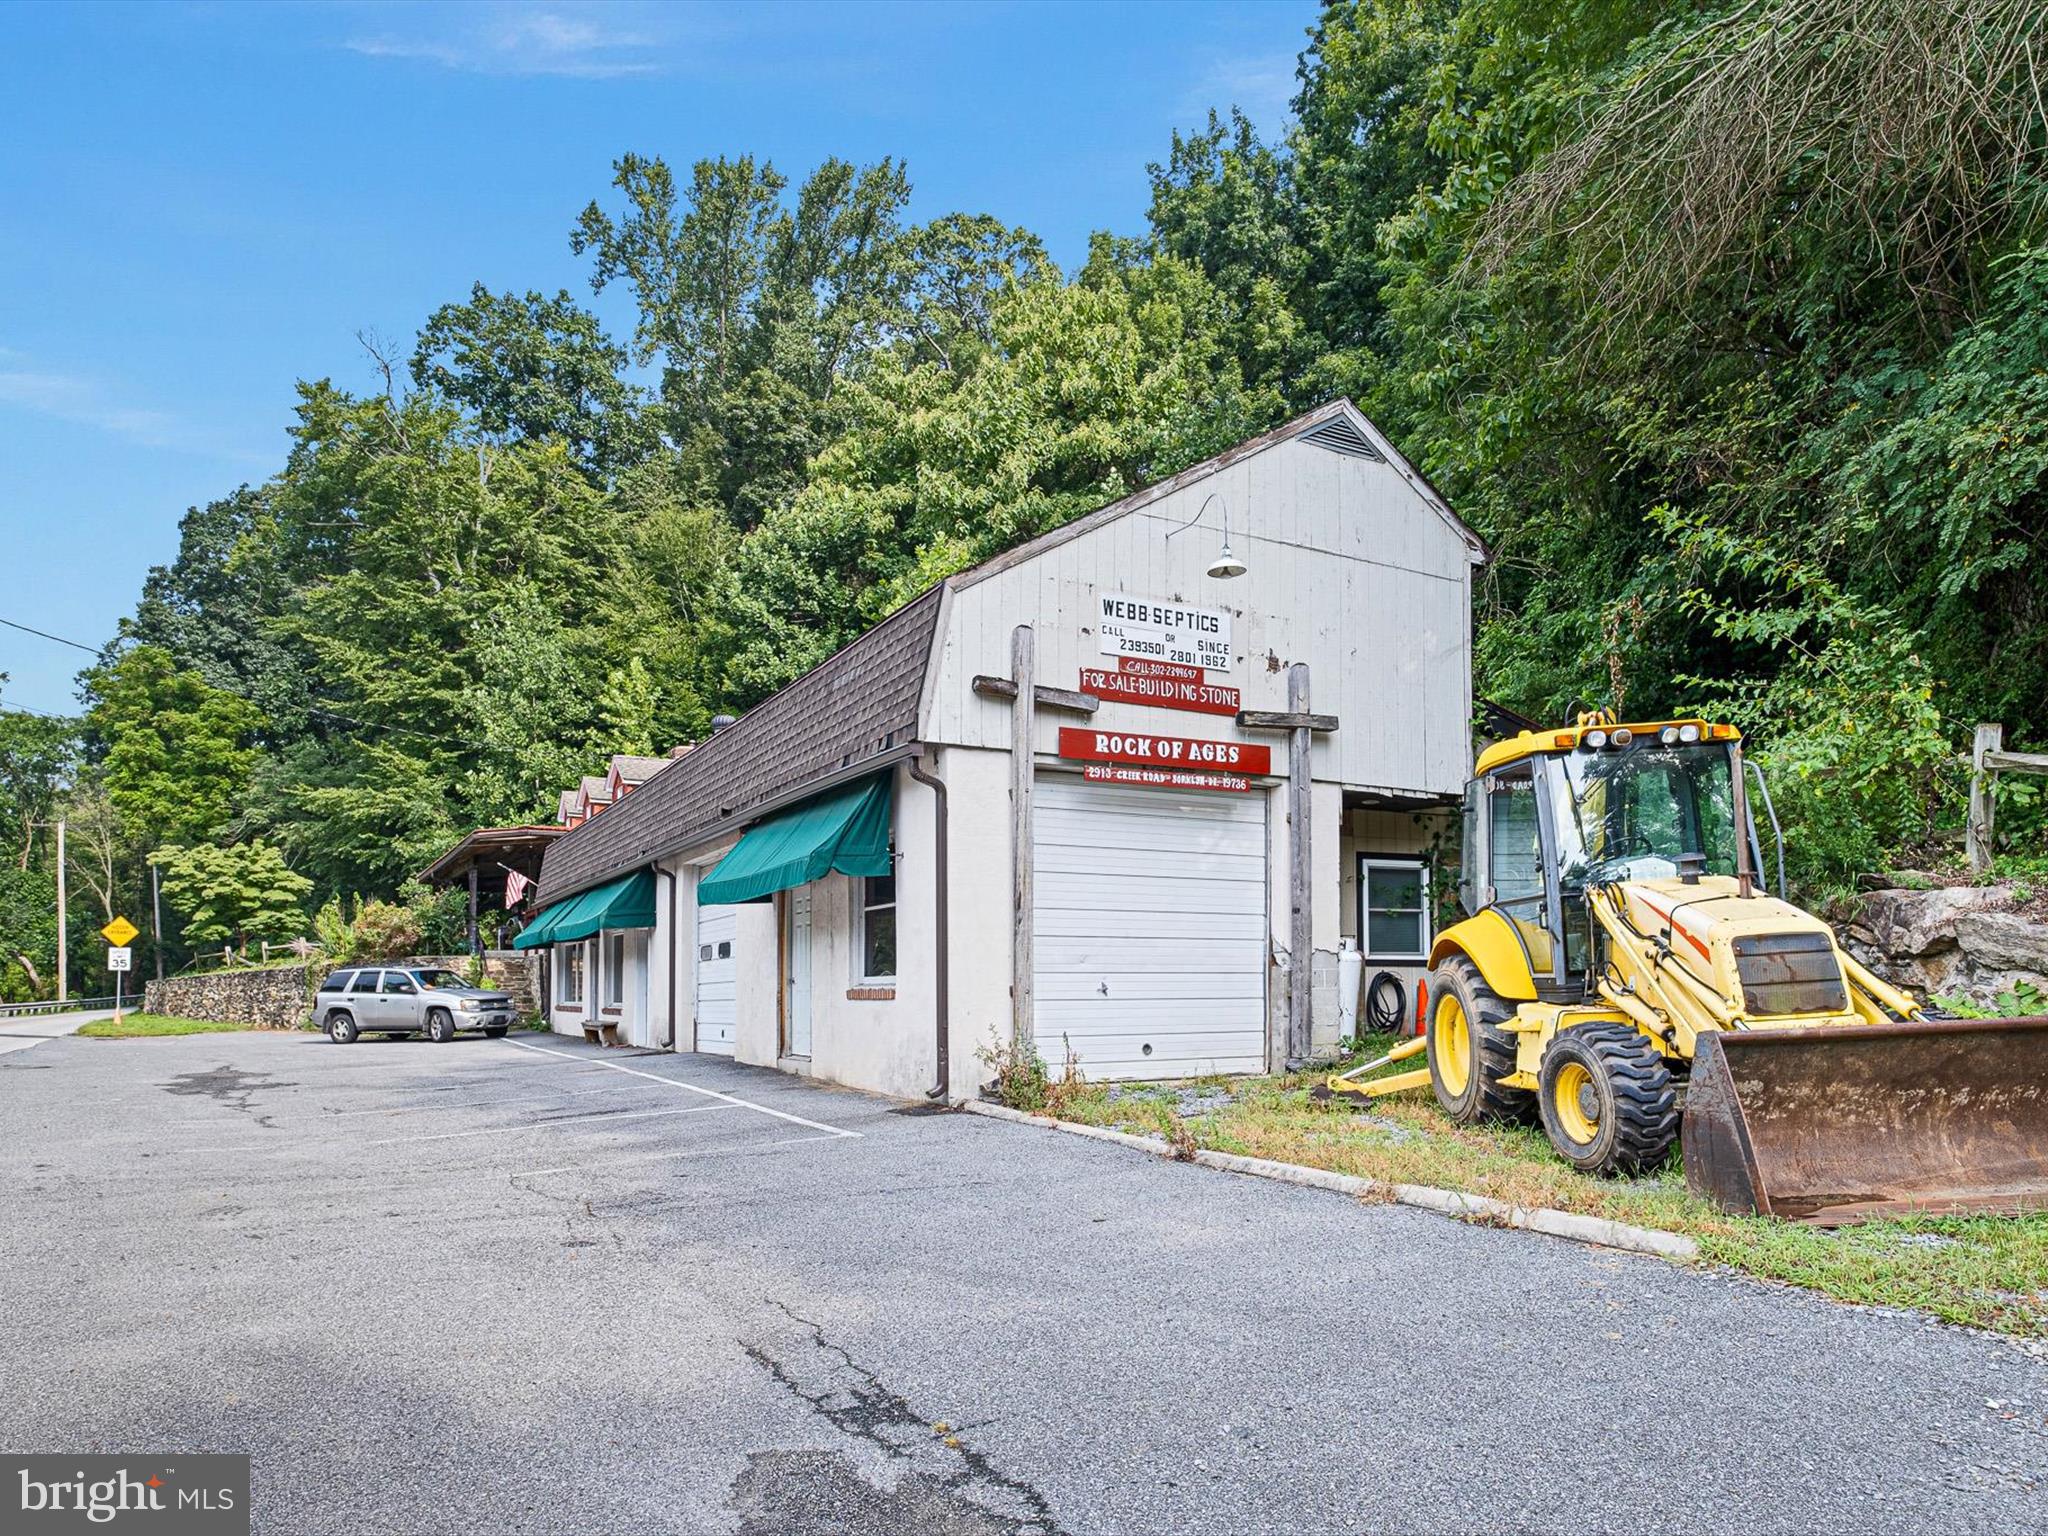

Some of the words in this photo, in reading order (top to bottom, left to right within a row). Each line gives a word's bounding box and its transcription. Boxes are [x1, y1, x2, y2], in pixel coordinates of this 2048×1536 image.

[1102, 625, 1125, 638] CALL
[1165, 633, 1176, 644] OR
[1198, 639, 1230, 655] SINCE
[1170, 650, 1197, 665] 2801
[1201, 655, 1227, 668] 1962
[1083, 672, 1107, 689] FOR
[1199, 688, 1239, 708] STONE
[1095, 734, 1152, 757] ROCK
[1157, 740, 1184, 759] OF
[1188, 743, 1240, 763] AGES
[112, 959, 128, 968] 35
